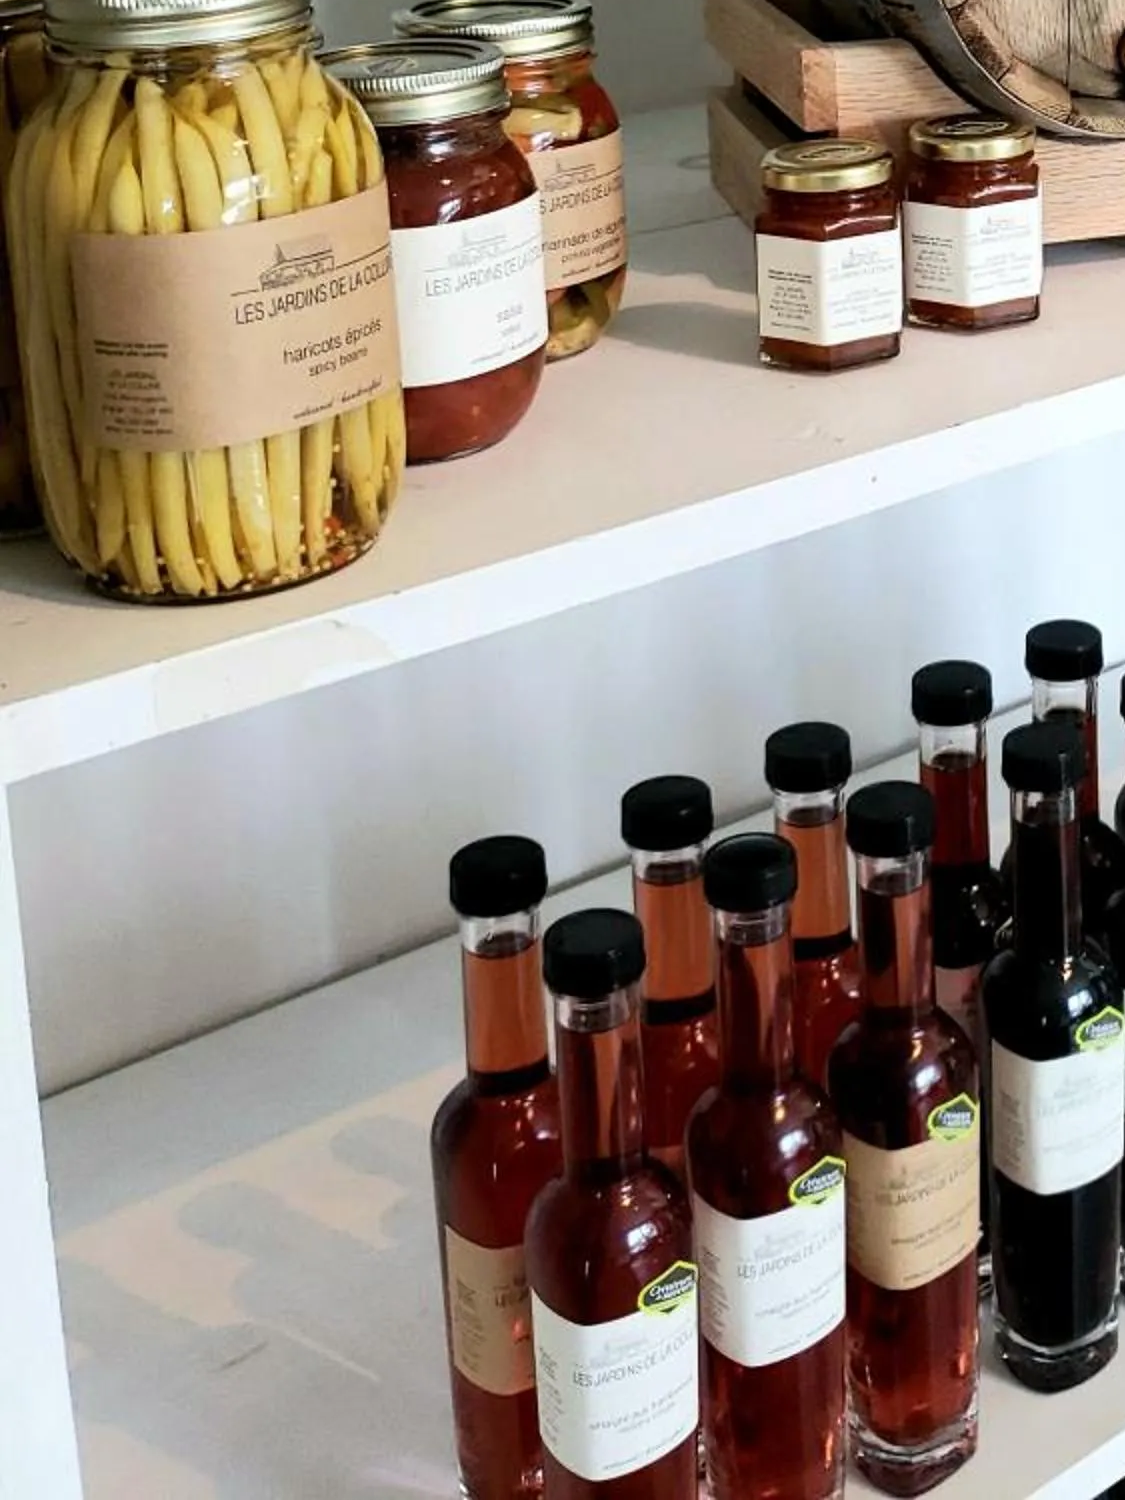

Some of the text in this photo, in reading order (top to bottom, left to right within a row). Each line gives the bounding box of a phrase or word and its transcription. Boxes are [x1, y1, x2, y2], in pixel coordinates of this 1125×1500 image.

[235, 301, 265, 325] LES
[268, 283, 328, 317] JARDINS
[329, 275, 348, 299] DE
[349, 270, 362, 292] LA
[425, 277, 451, 298] LES
[282, 334, 343, 364] haricots
